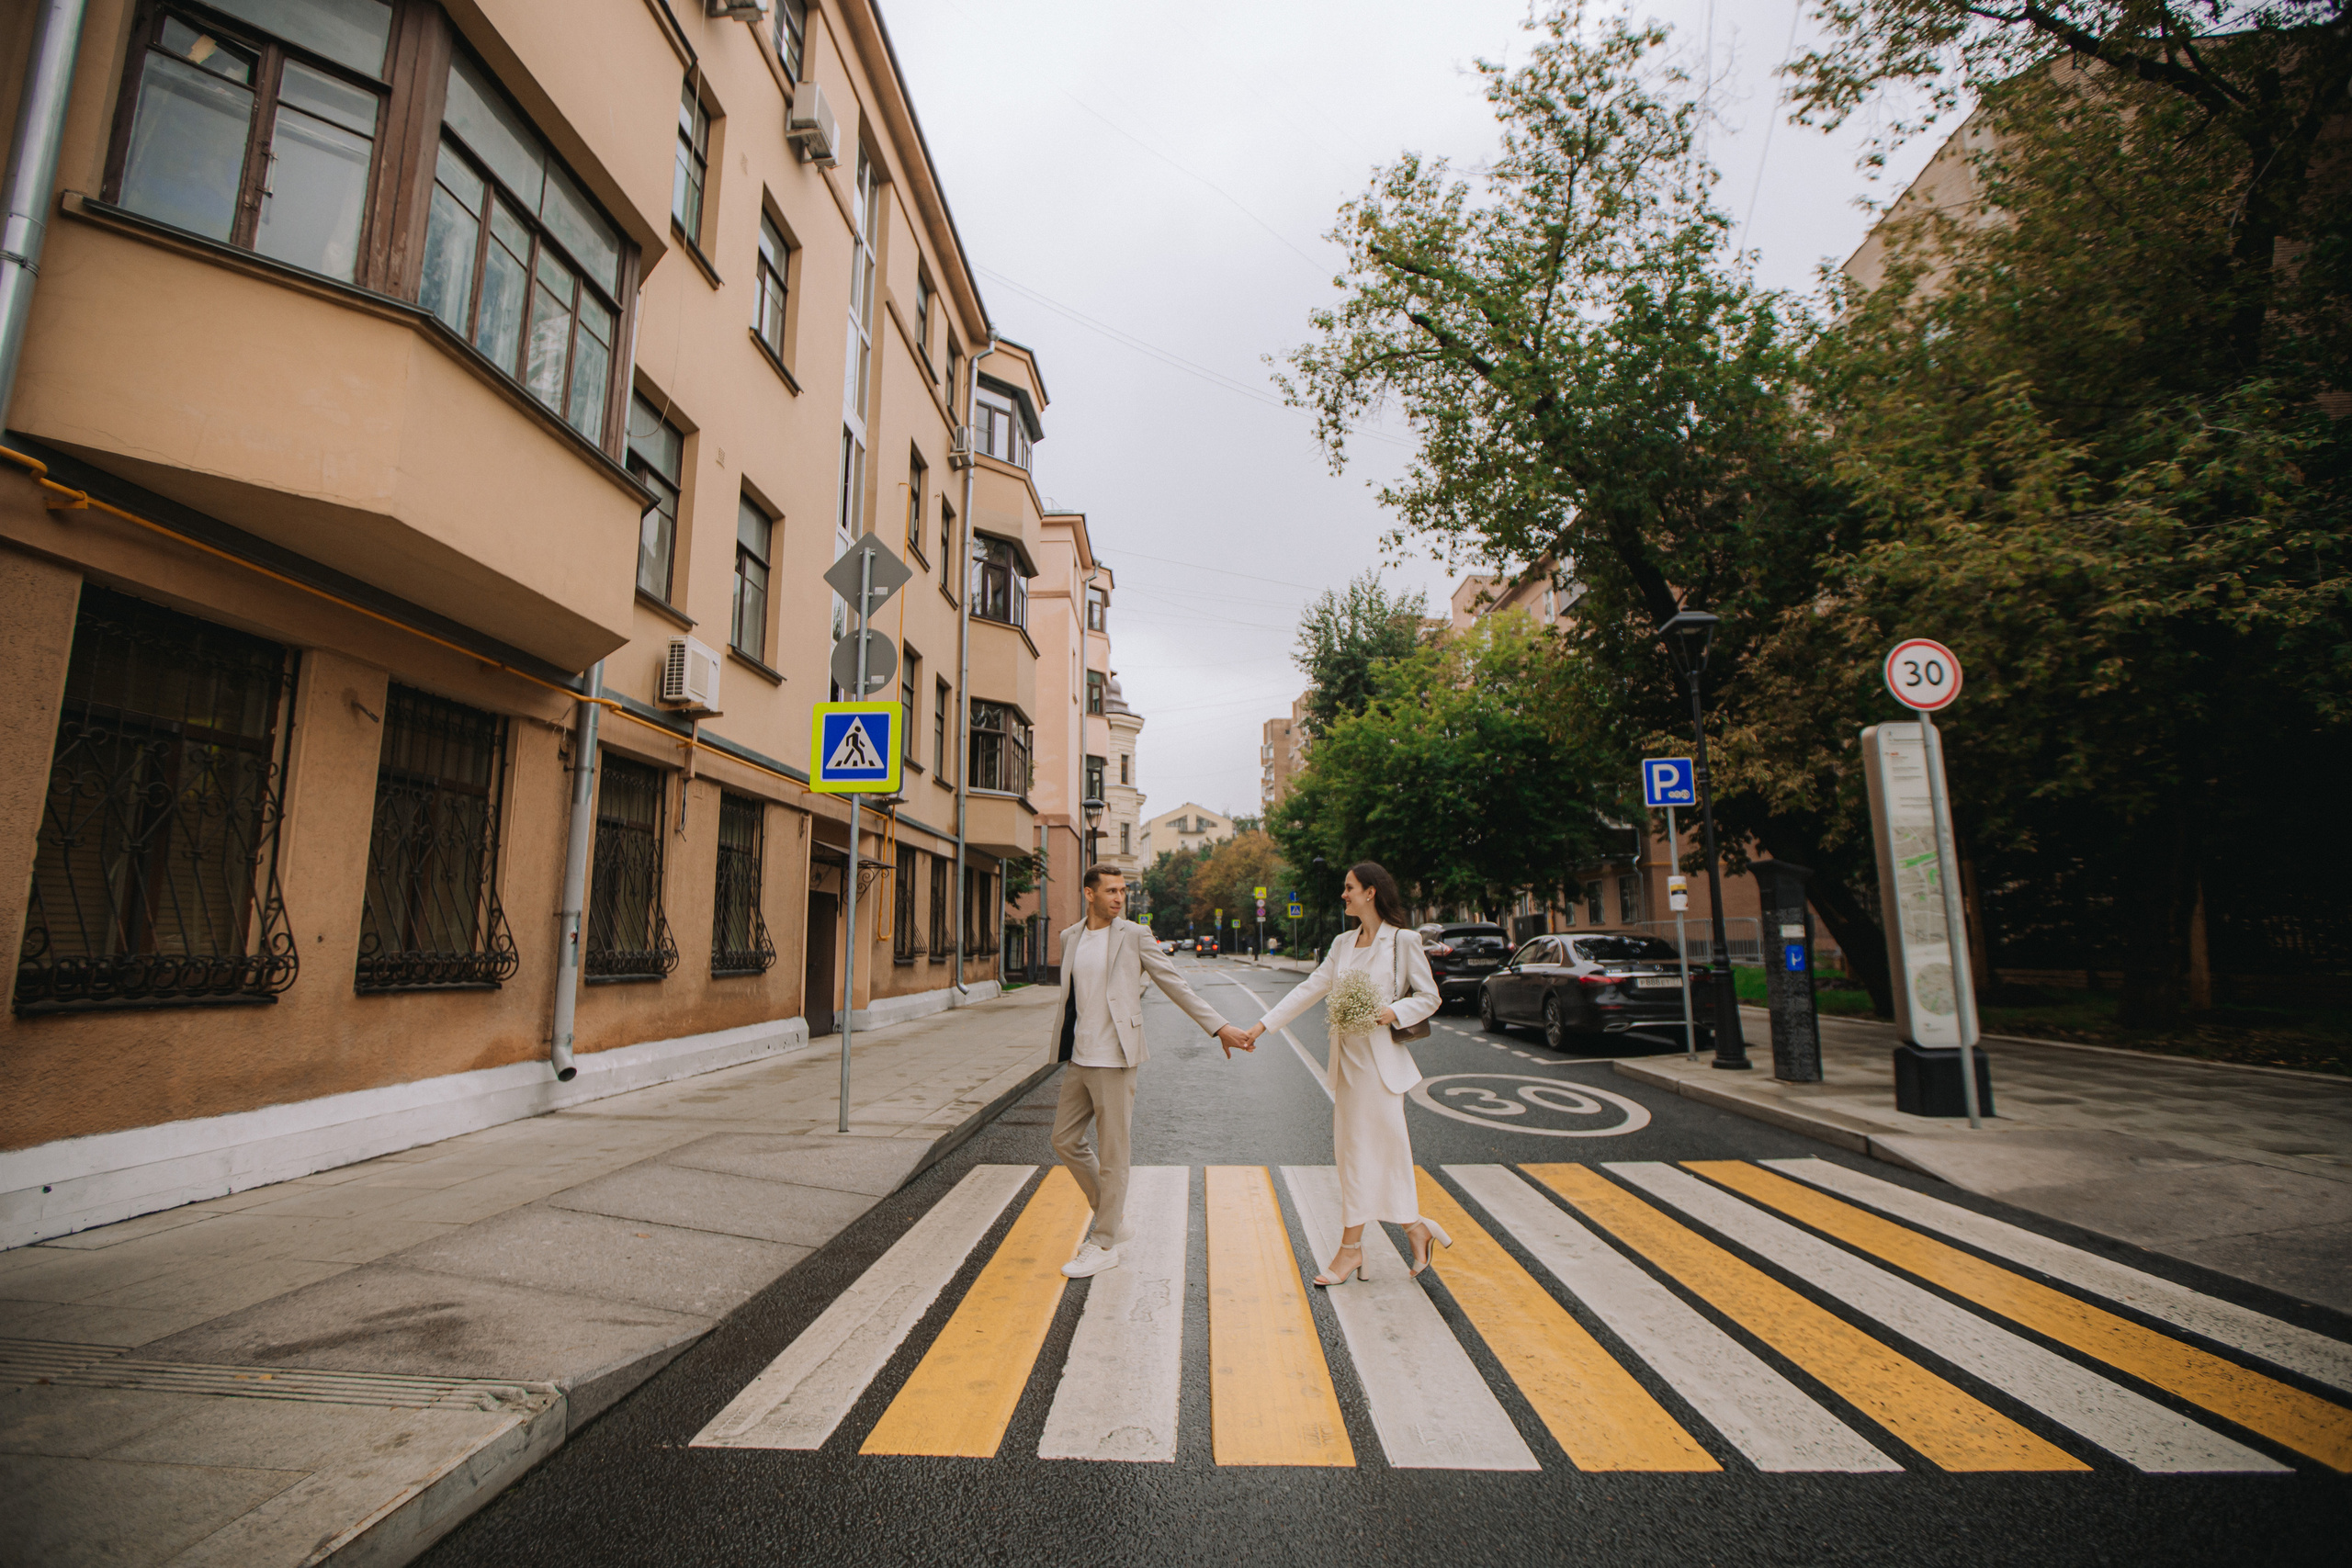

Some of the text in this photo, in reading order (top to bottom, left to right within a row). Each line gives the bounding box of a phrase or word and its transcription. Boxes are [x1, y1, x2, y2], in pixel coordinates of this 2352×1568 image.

[1904, 660, 1945, 686] 30
[1652, 763, 1679, 801] P
[1444, 1086, 1602, 1115] 30
